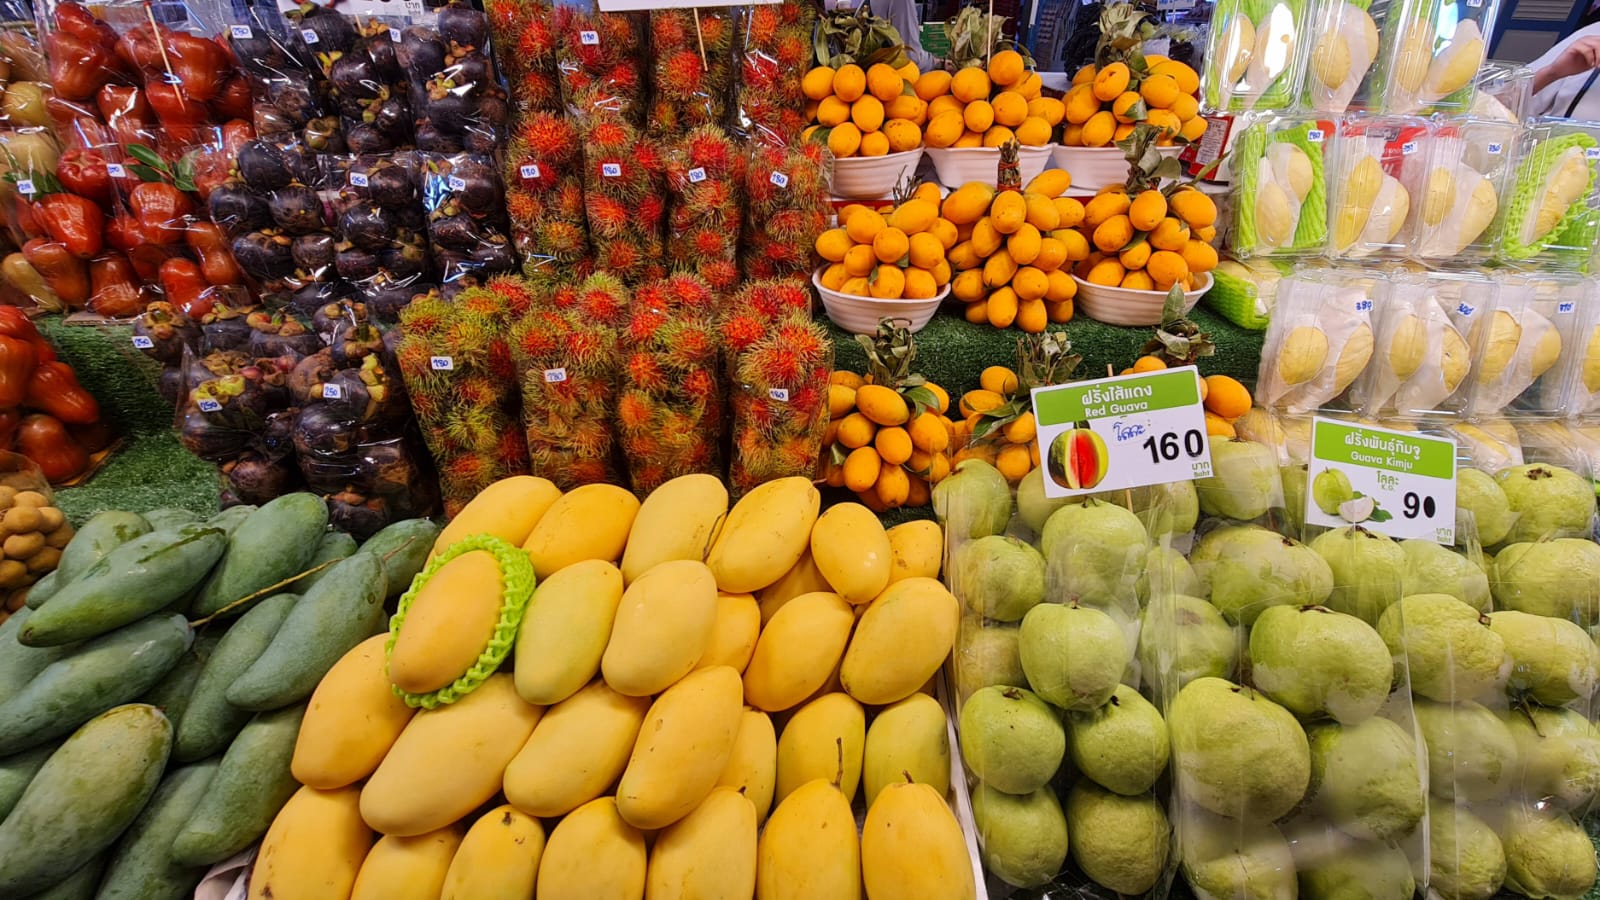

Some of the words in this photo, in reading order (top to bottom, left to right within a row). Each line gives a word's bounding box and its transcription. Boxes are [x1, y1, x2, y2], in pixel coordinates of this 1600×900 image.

[325, 386, 338, 397] 250
[1081, 384, 1153, 406] ฝรั่งไส้แดง
[1084, 405, 1106, 418] Red
[1110, 401, 1148, 414] Guava
[1143, 429, 1204, 464] 160
[1344, 429, 1421, 461] ฝรั่งพันธุ์กิมจู
[1192, 461, 1210, 471] บาท
[1351, 451, 1383, 465] Guava
[1386, 456, 1413, 471] Kimju
[1402, 492, 1436, 519] 90
[1436, 527, 1452, 537] บาท
